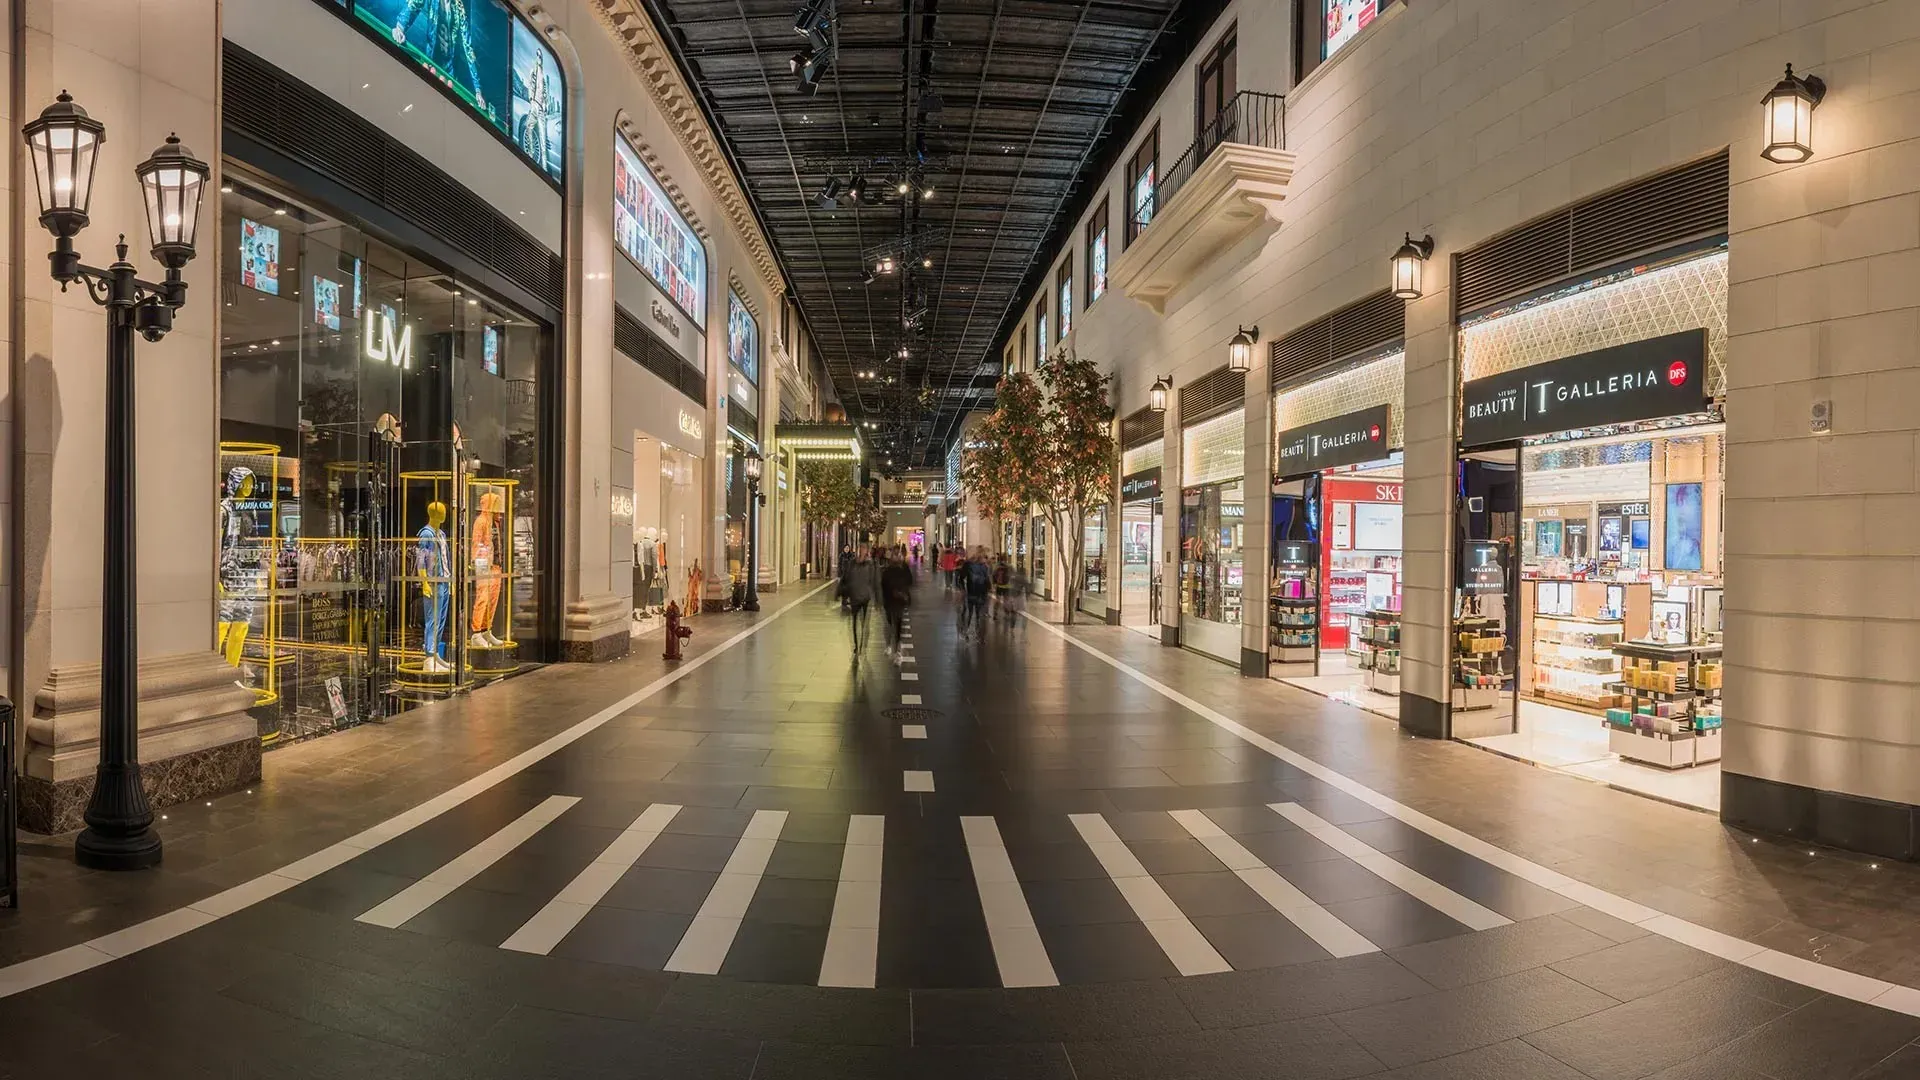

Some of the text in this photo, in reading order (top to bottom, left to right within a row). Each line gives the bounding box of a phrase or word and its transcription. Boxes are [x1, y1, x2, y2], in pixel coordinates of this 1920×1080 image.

[1469, 367, 1686, 419] BEAUTY T GALLERIA DFS
[1280, 443, 1305, 459] BEAUTY
[1310, 434, 1323, 457] T
[1321, 430, 1368, 449] GALLERIA
[312, 598, 331, 608] BOSS
